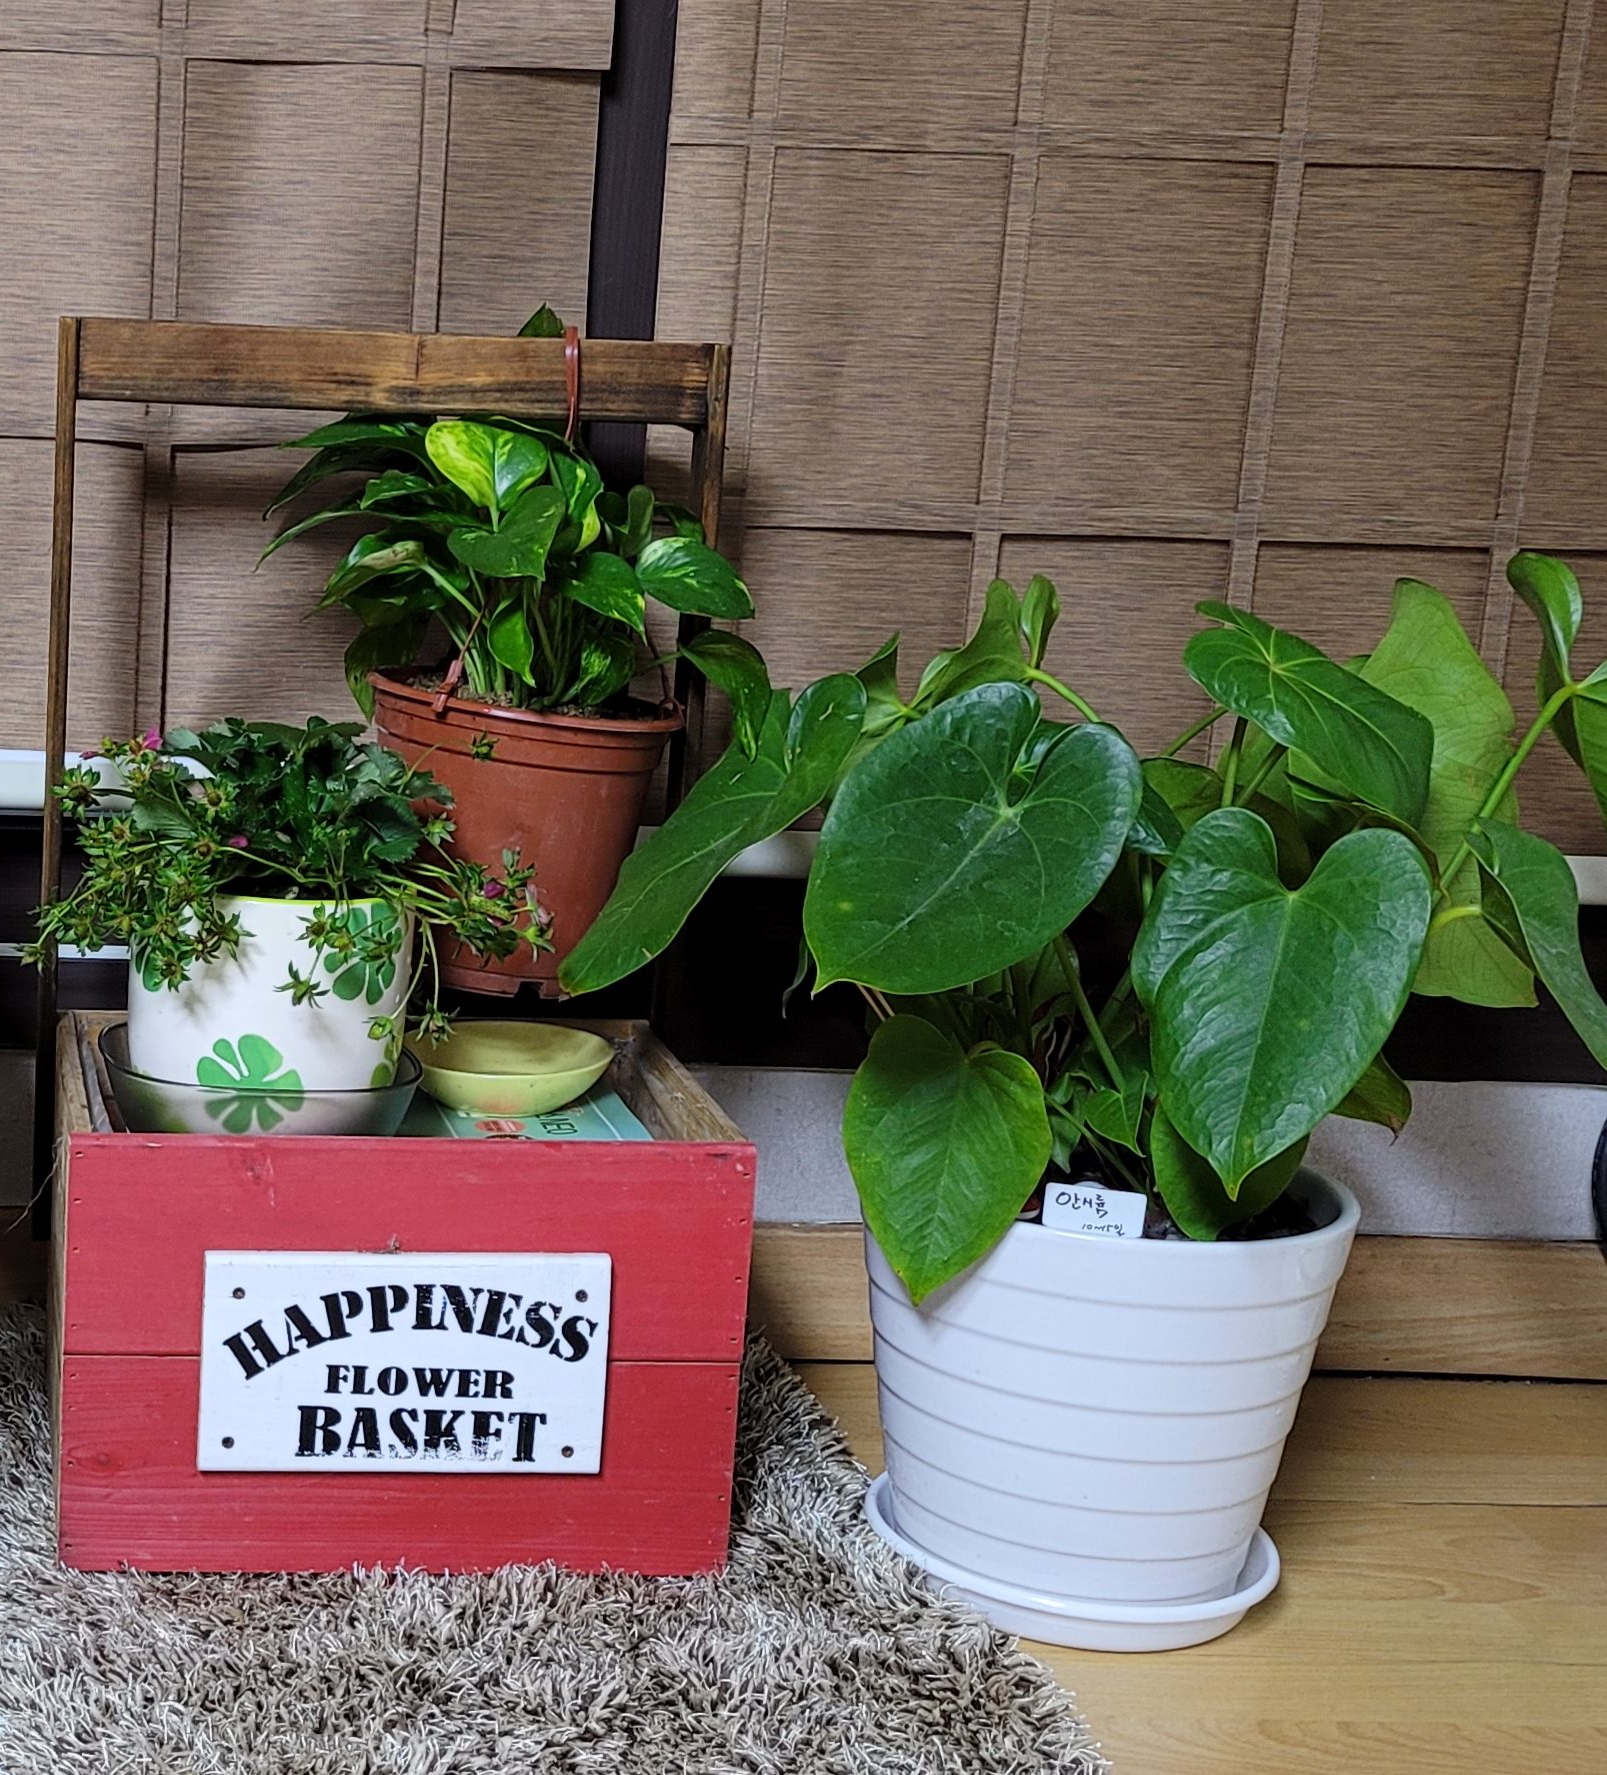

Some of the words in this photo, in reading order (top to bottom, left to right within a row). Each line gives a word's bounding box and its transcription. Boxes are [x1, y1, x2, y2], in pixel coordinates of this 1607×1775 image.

[221, 1283, 599, 1381] HAPPINESS
[323, 1363, 515, 1400] FLOWER
[294, 1404, 547, 1463] BASKET
